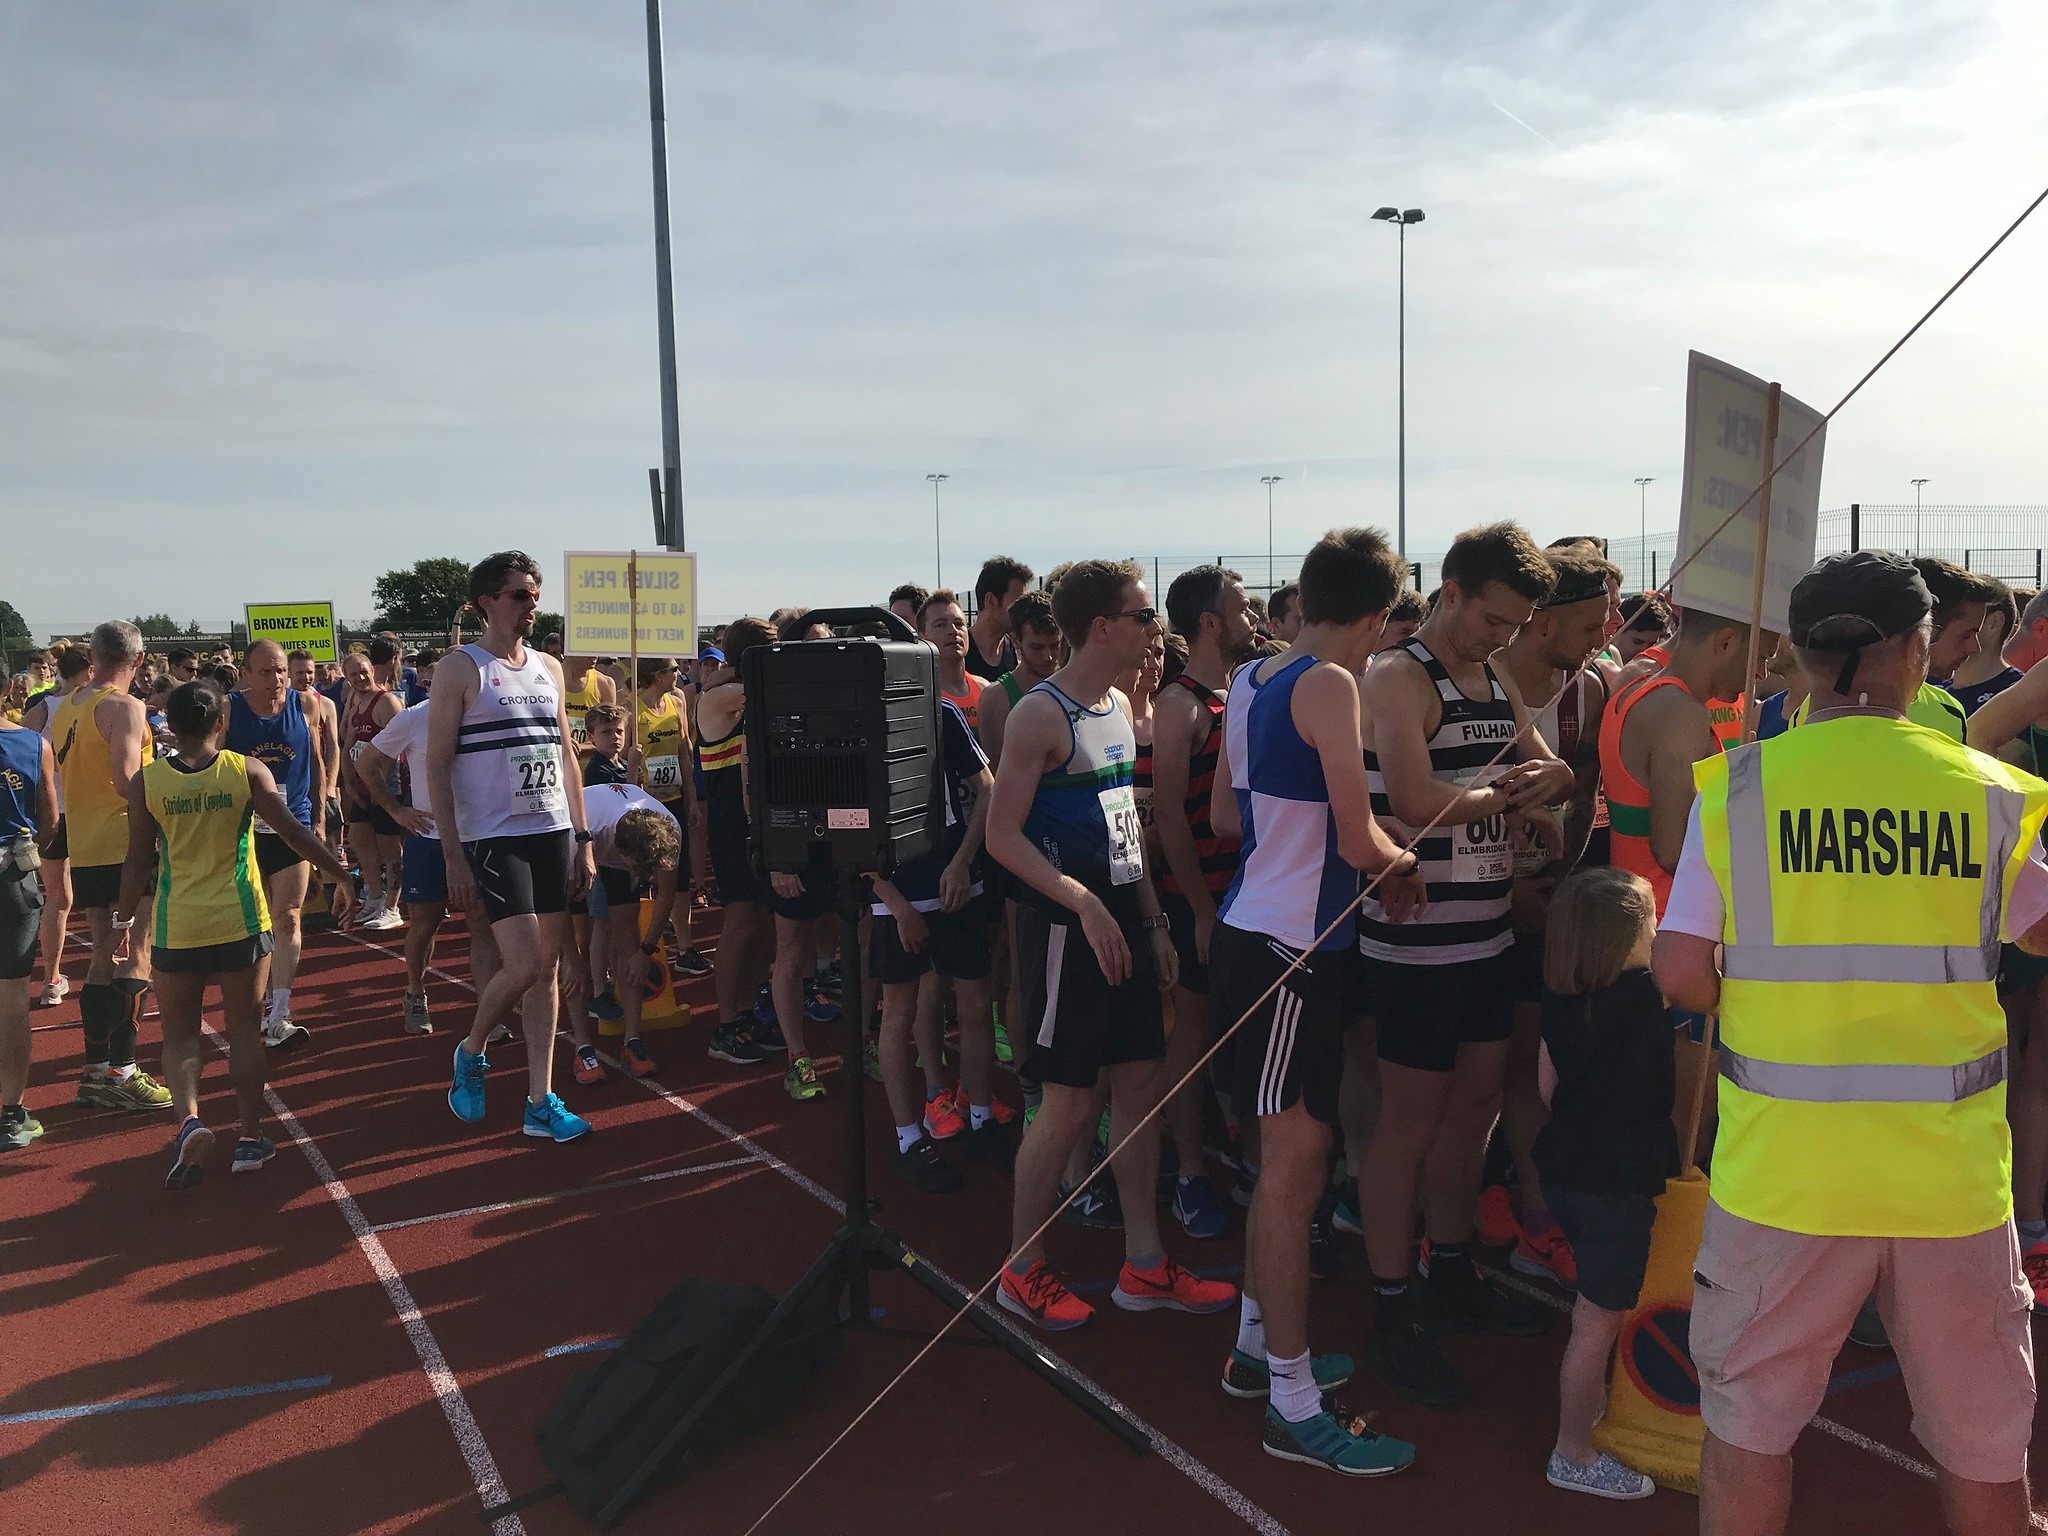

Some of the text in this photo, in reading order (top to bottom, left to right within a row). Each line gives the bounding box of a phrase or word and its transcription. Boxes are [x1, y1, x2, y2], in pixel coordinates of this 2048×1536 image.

[253, 616, 328, 631] BRONZE PEN:
[282, 639, 331, 650] NUTES PLUS
[416, 640, 429, 648] OF
[498, 695, 554, 706] CROYDON
[1461, 723, 1516, 741] FULHAM
[250, 742, 297, 761] ANELAGH
[1103, 743, 1125, 755] clapham
[510, 753, 549, 763] PRODUCTS
[1105, 751, 1125, 762] chasers
[518, 760, 557, 791] 223
[653, 766, 677, 785] 487
[515, 788, 552, 798] ELMBRIDGE
[162, 795, 193, 816] Striders
[203, 789, 233, 812] Croydon
[1457, 844, 1507, 855] ELMBRIDGE
[1779, 807, 1982, 880] MARSHAL
